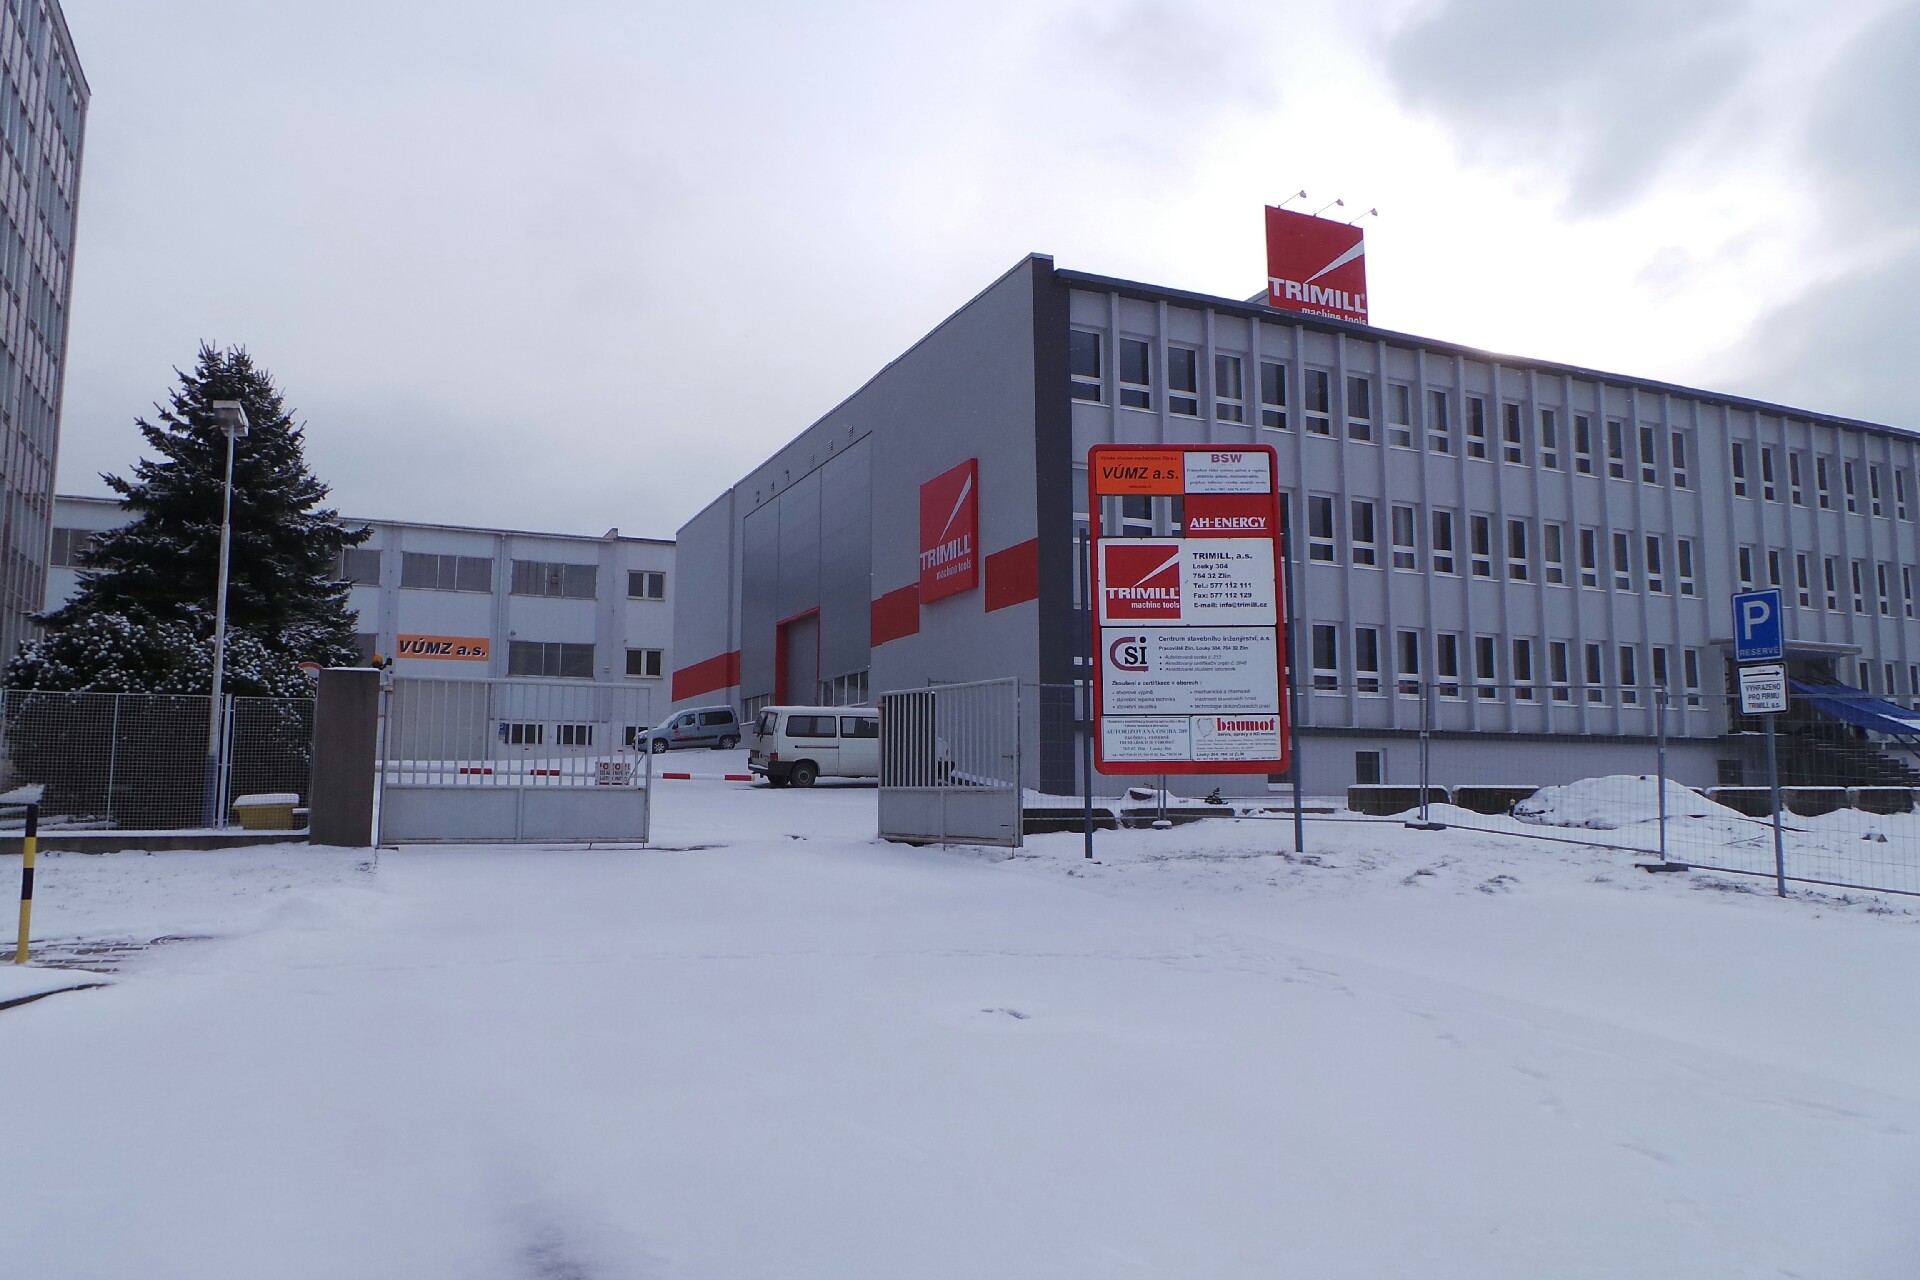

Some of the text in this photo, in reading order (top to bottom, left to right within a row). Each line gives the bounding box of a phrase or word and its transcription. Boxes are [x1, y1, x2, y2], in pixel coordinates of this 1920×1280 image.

[1268, 276, 1367, 314] TRIMILL
[1211, 453, 1243, 463] BSW
[1102, 463, 1179, 480] VÚMZ a.s.
[1190, 516, 1266, 529] AH-ENERGY
[920, 534, 971, 571] TRIMILL
[1192, 552, 1234, 560] TRIMILL,
[937, 558, 971, 580] machine tools
[1105, 587, 1180, 599] TRIMILL
[1131, 599, 1180, 609] machine tools
[1743, 600, 1770, 640] P
[400, 638, 487, 657] VÚMZ a.s.
[1748, 692, 1760, 700] PRO
[1216, 717, 1275, 731] baumot
